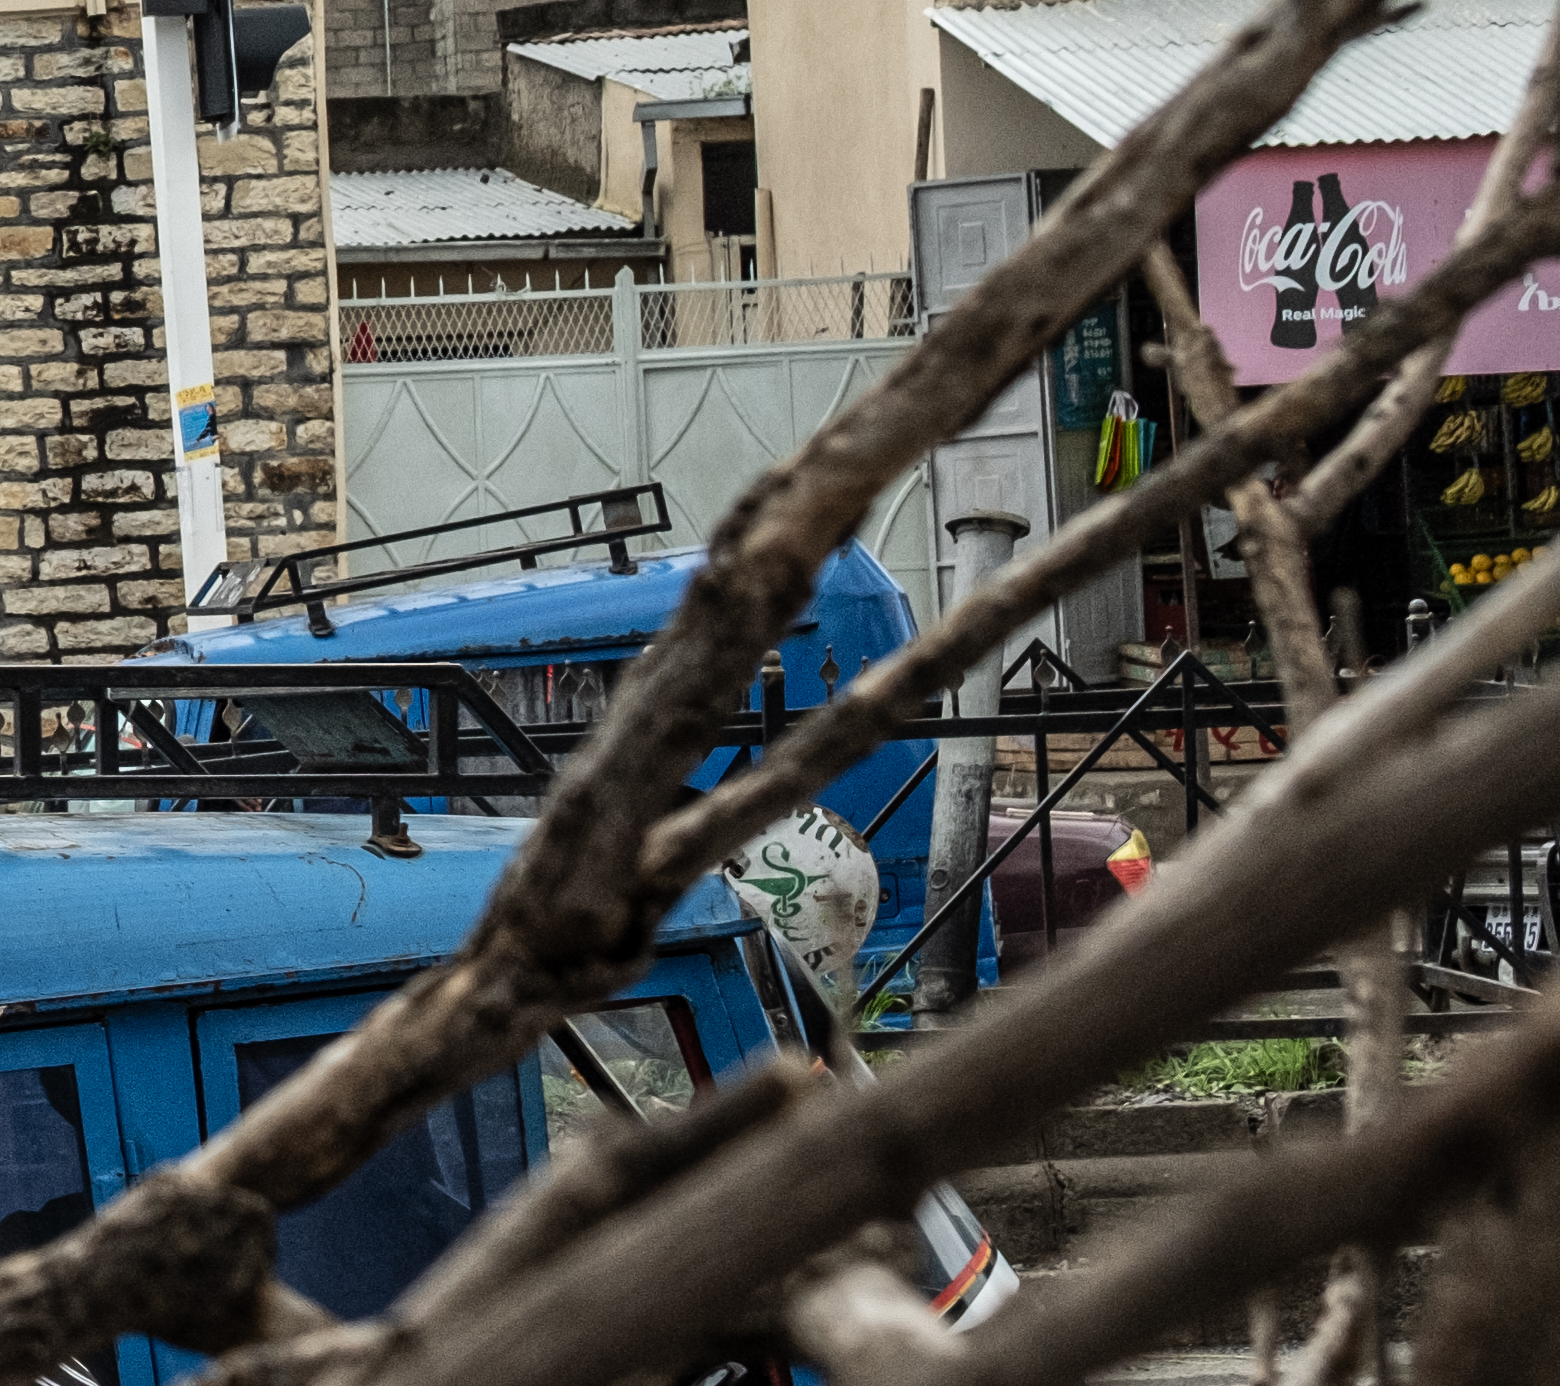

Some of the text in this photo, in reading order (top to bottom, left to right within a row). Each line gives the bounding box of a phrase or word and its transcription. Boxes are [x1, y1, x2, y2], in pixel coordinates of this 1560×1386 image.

[1238, 199, 1408, 292] Coca-Cola
[1281, 305, 1367, 322] Real Magic
